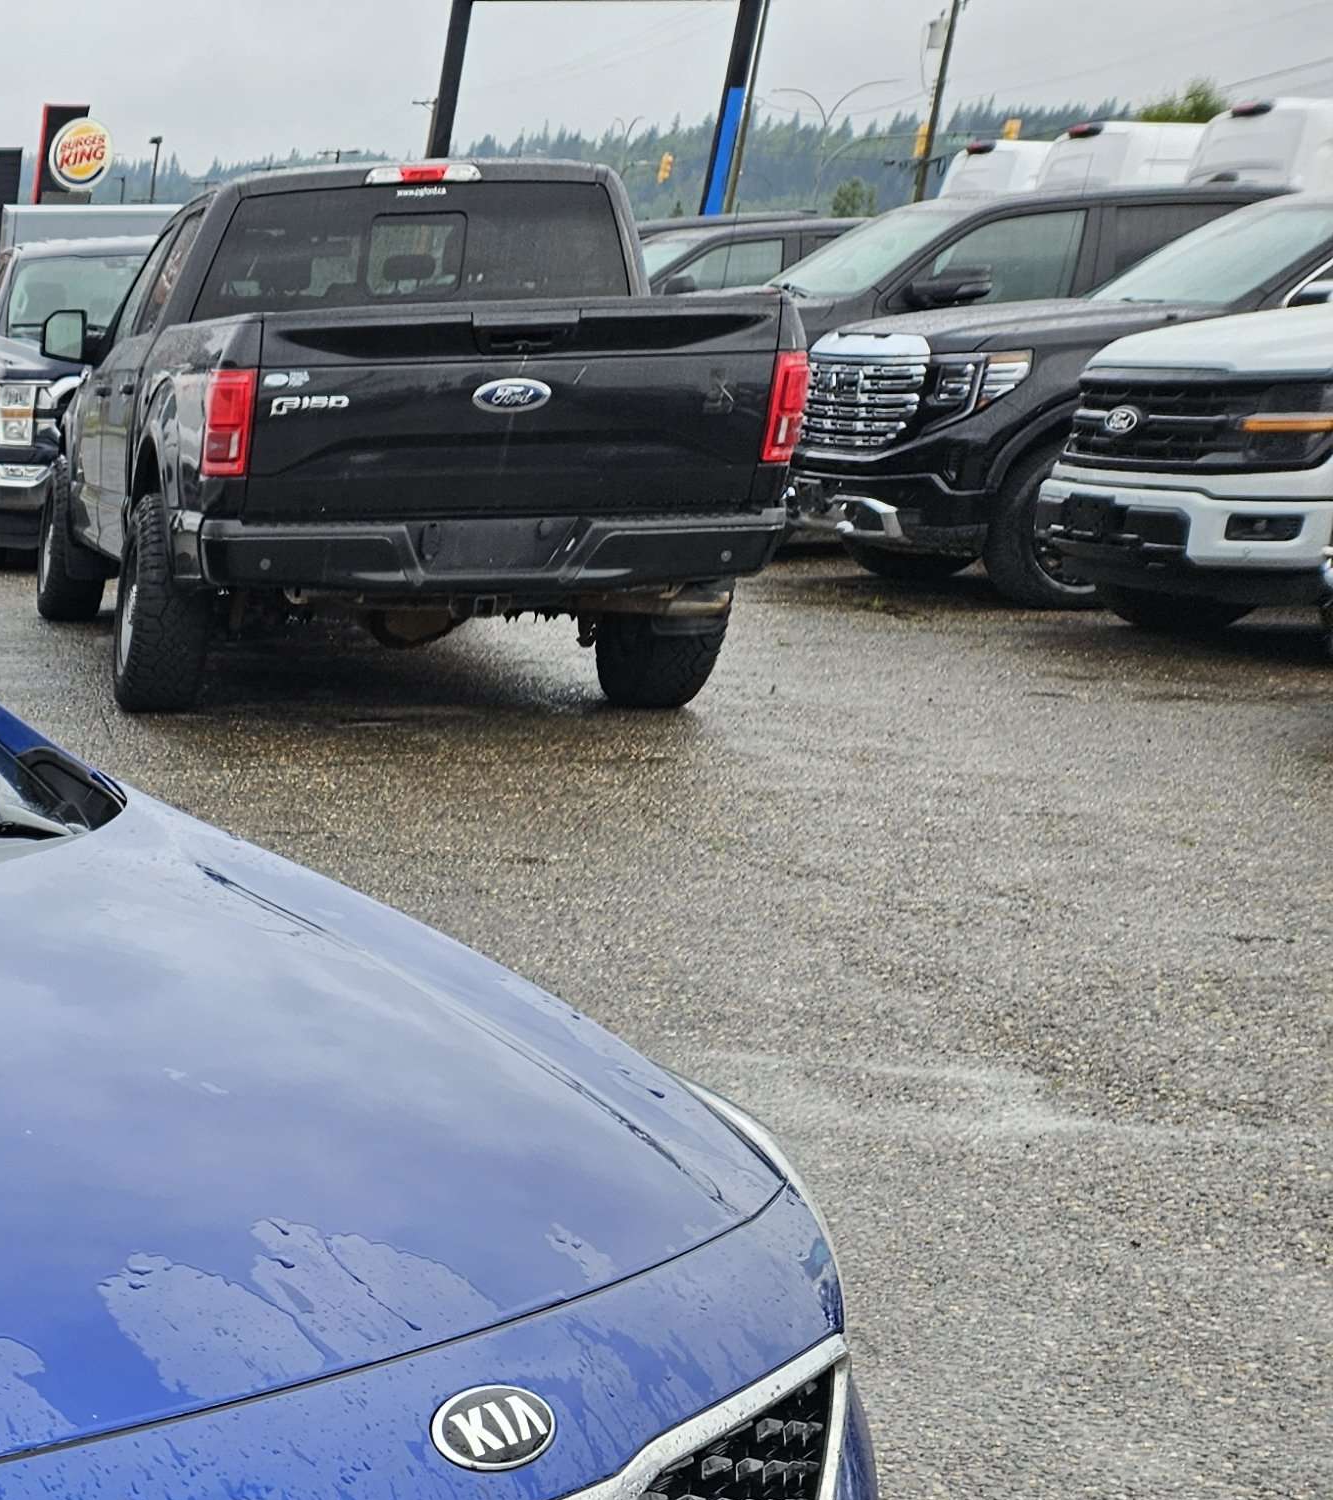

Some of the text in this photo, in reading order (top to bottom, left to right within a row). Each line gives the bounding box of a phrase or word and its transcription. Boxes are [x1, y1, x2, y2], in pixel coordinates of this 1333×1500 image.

[60, 134, 106, 153] BURGER
[59, 145, 106, 169] KING
[491, 384, 534, 404] Ford
[448, 1395, 549, 1457] KIA
